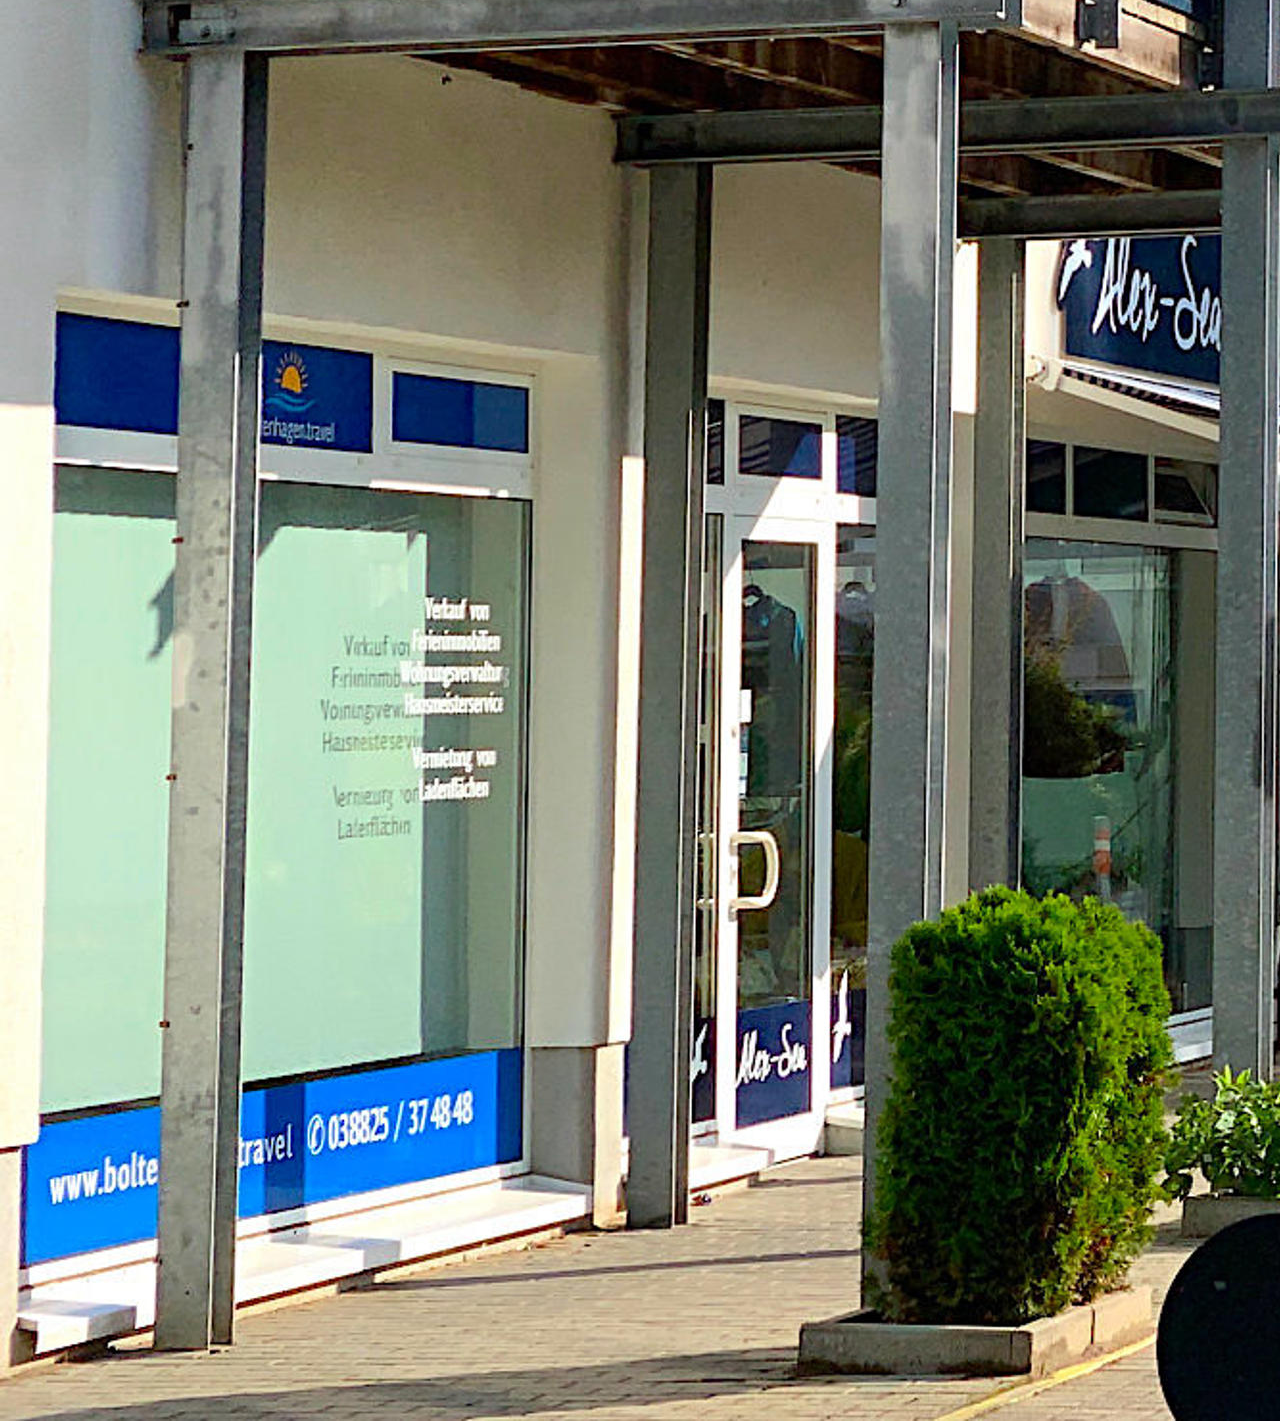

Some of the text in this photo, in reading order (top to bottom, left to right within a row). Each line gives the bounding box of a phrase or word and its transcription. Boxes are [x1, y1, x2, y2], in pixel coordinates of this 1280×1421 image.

[469, 604, 490, 621] von
[475, 749, 497, 767] von
[328, 1105, 389, 1151] 038825
